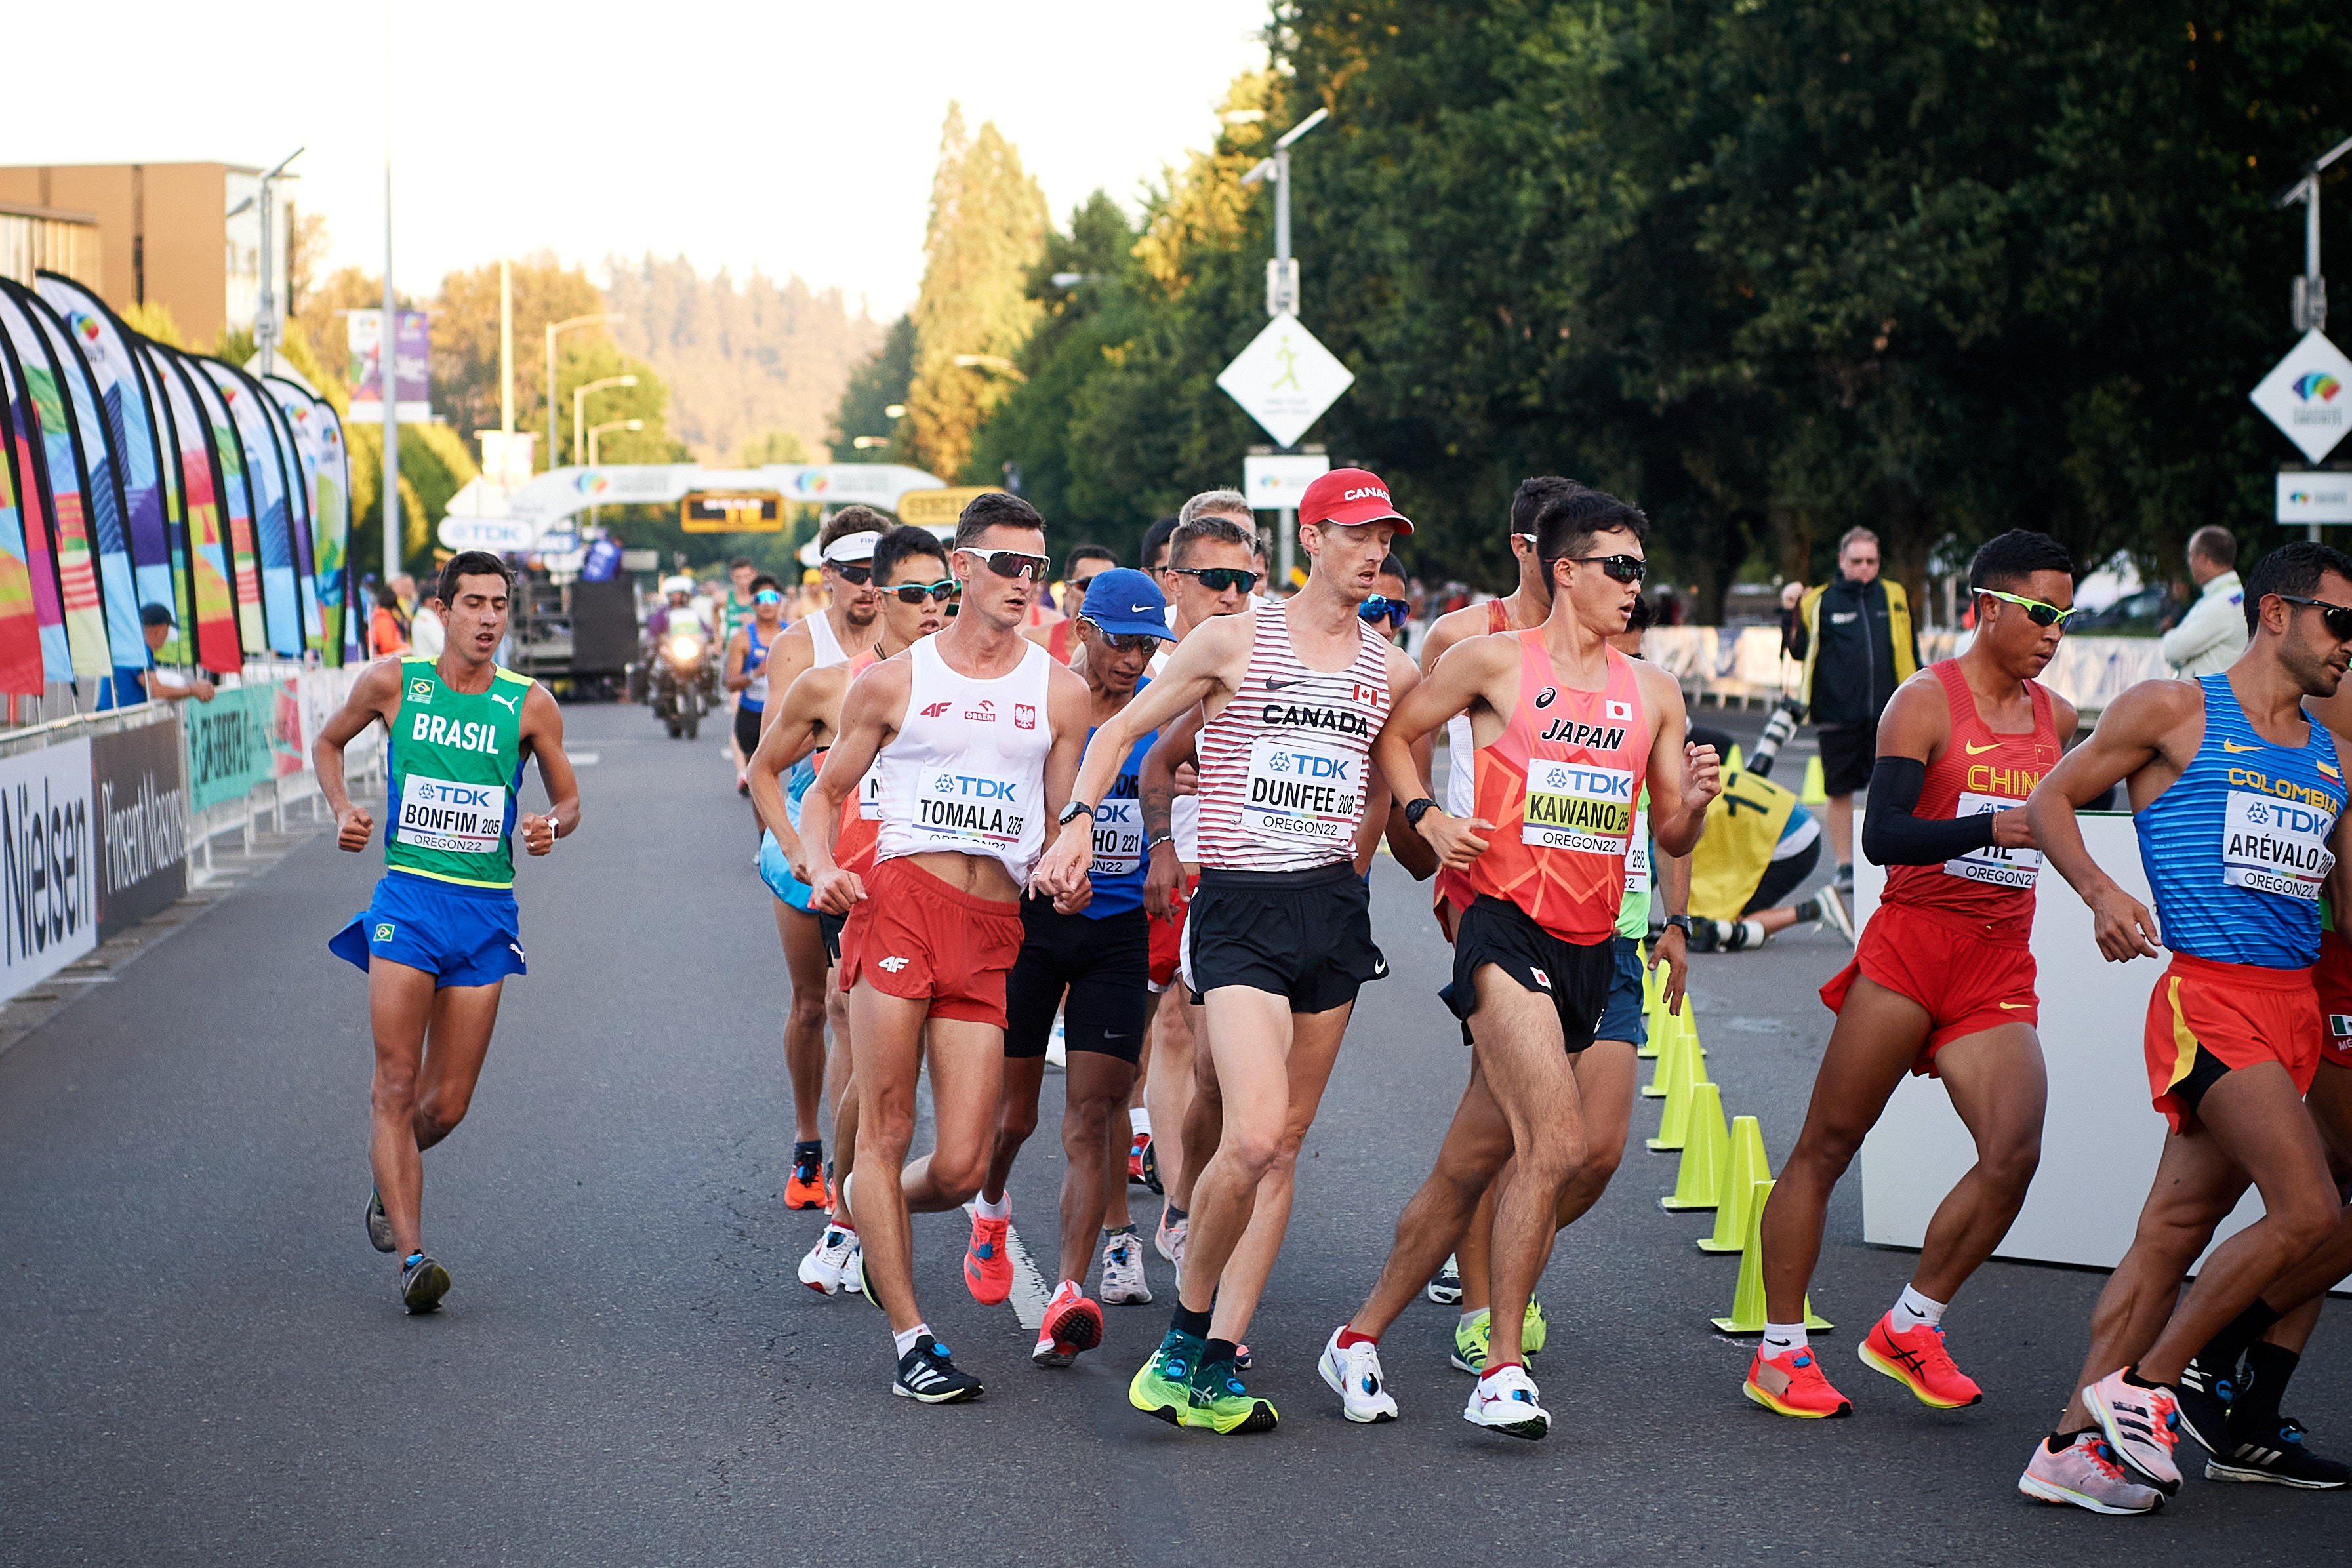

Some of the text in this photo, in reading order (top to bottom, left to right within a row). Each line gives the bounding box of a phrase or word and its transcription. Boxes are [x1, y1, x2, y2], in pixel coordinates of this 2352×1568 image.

[1344, 487, 1394, 508] CANAD
[920, 702, 952, 717] 4F
[965, 712, 994, 721] ORLEN
[1263, 704, 1368, 738] CANADA
[412, 712, 499, 755] BRASIL
[1541, 719, 1625, 750] JAPAN
[1291, 754, 1350, 780] TDK
[1968, 765, 2041, 796] CHIN
[436, 785, 491, 807] TDK
[955, 776, 1017, 802] TDK
[1251, 778, 1355, 815] DUNFEE 208
[1568, 769, 1631, 797] TDK
[2228, 767, 2338, 814] COLOMBIA
[405, 803, 500, 835] BONFIM 205
[920, 799, 1024, 835] TOMALA 275
[1094, 805, 1130, 822] DK
[1263, 816, 1338, 836] OREGON22
[1530, 795, 1616, 830] KAWANO
[2269, 804, 2328, 837] TDK
[101, 778, 147, 895] Pinsent
[413, 834, 482, 852] OREGON22
[1092, 830, 1139, 853] HO 221
[1543, 832, 1617, 853] OREGON22
[1632, 849, 1645, 869] 268
[2228, 833, 2319, 871] ARÉVALO
[2, 775, 89, 967] Nielsen
[2244, 872, 2315, 898] OREGON22
[878, 955, 910, 973] 4F
